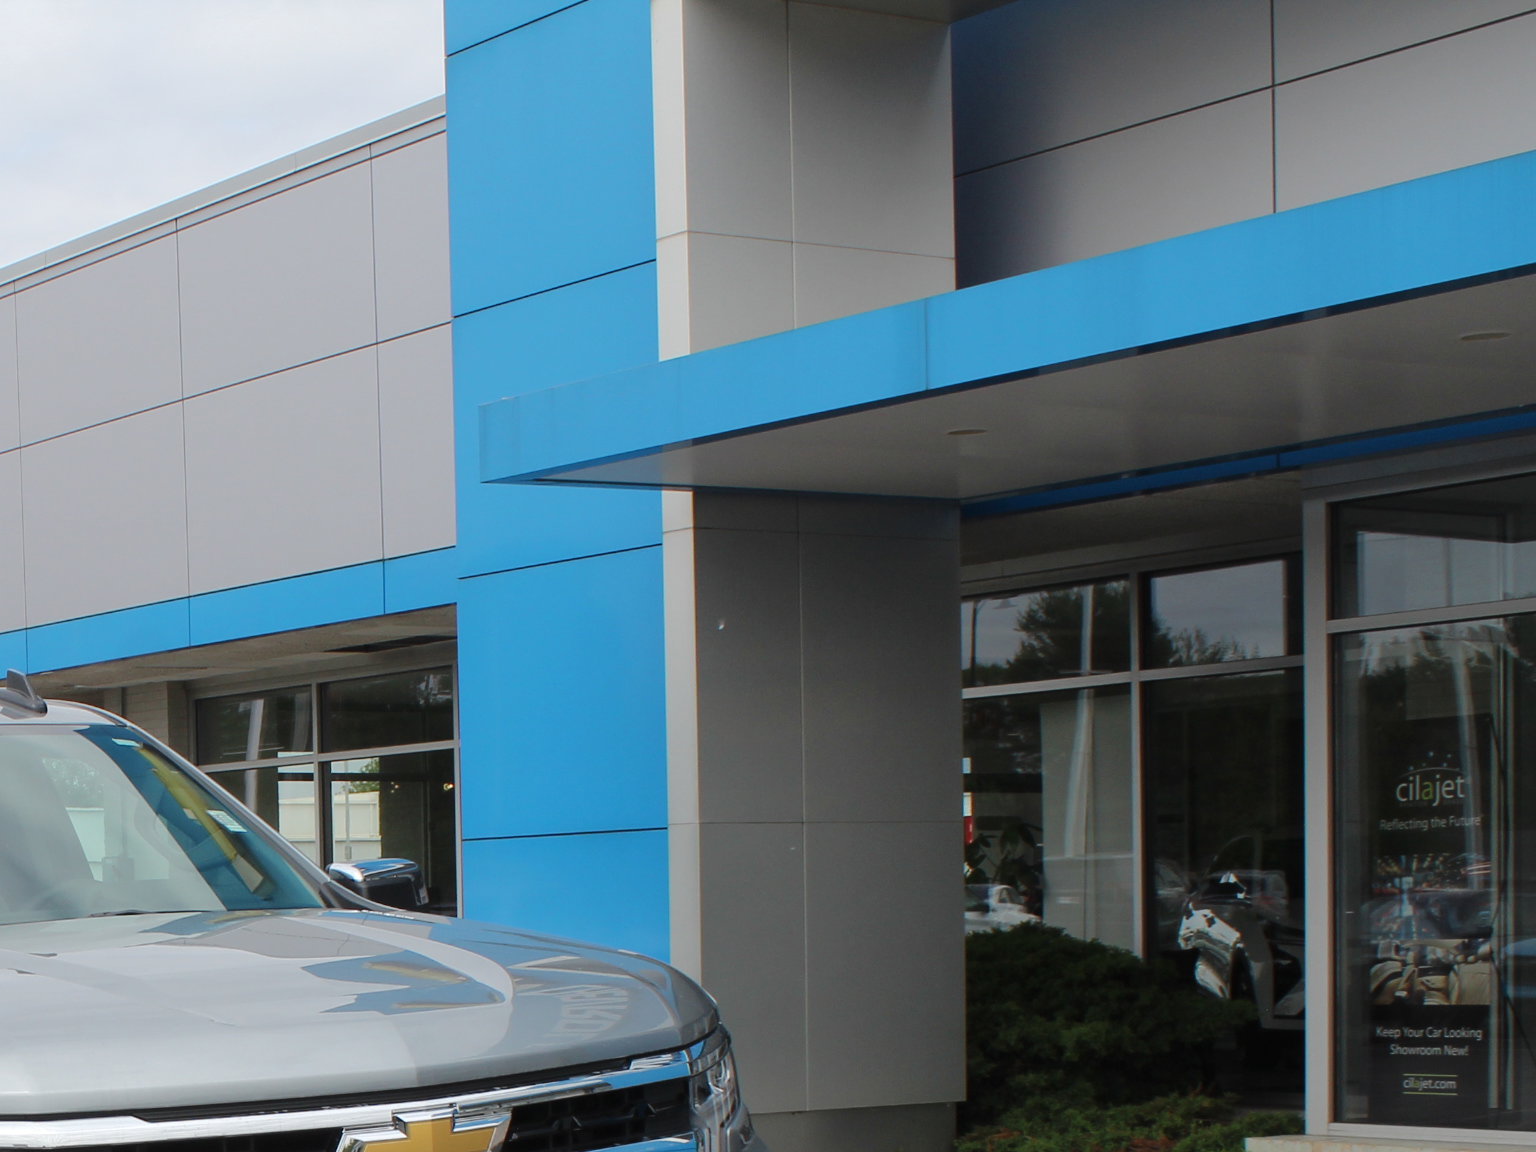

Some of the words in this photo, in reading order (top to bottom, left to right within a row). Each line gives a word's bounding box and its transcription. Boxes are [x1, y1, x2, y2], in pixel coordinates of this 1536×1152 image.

[1395, 774, 1465, 807] cilajet
[1379, 818, 1429, 831] Reflecting
[1430, 816, 1447, 828] the
[1376, 1026, 1401, 1040] Keep
[1402, 1026, 1424, 1038] Your
[1425, 1026, 1442, 1038] Car
[1444, 1027, 1483, 1041] Looking
[1390, 1043, 1441, 1055] Showroom
[1444, 1044, 1469, 1056] New!
[1403, 1076, 1457, 1091] cilajet.com
